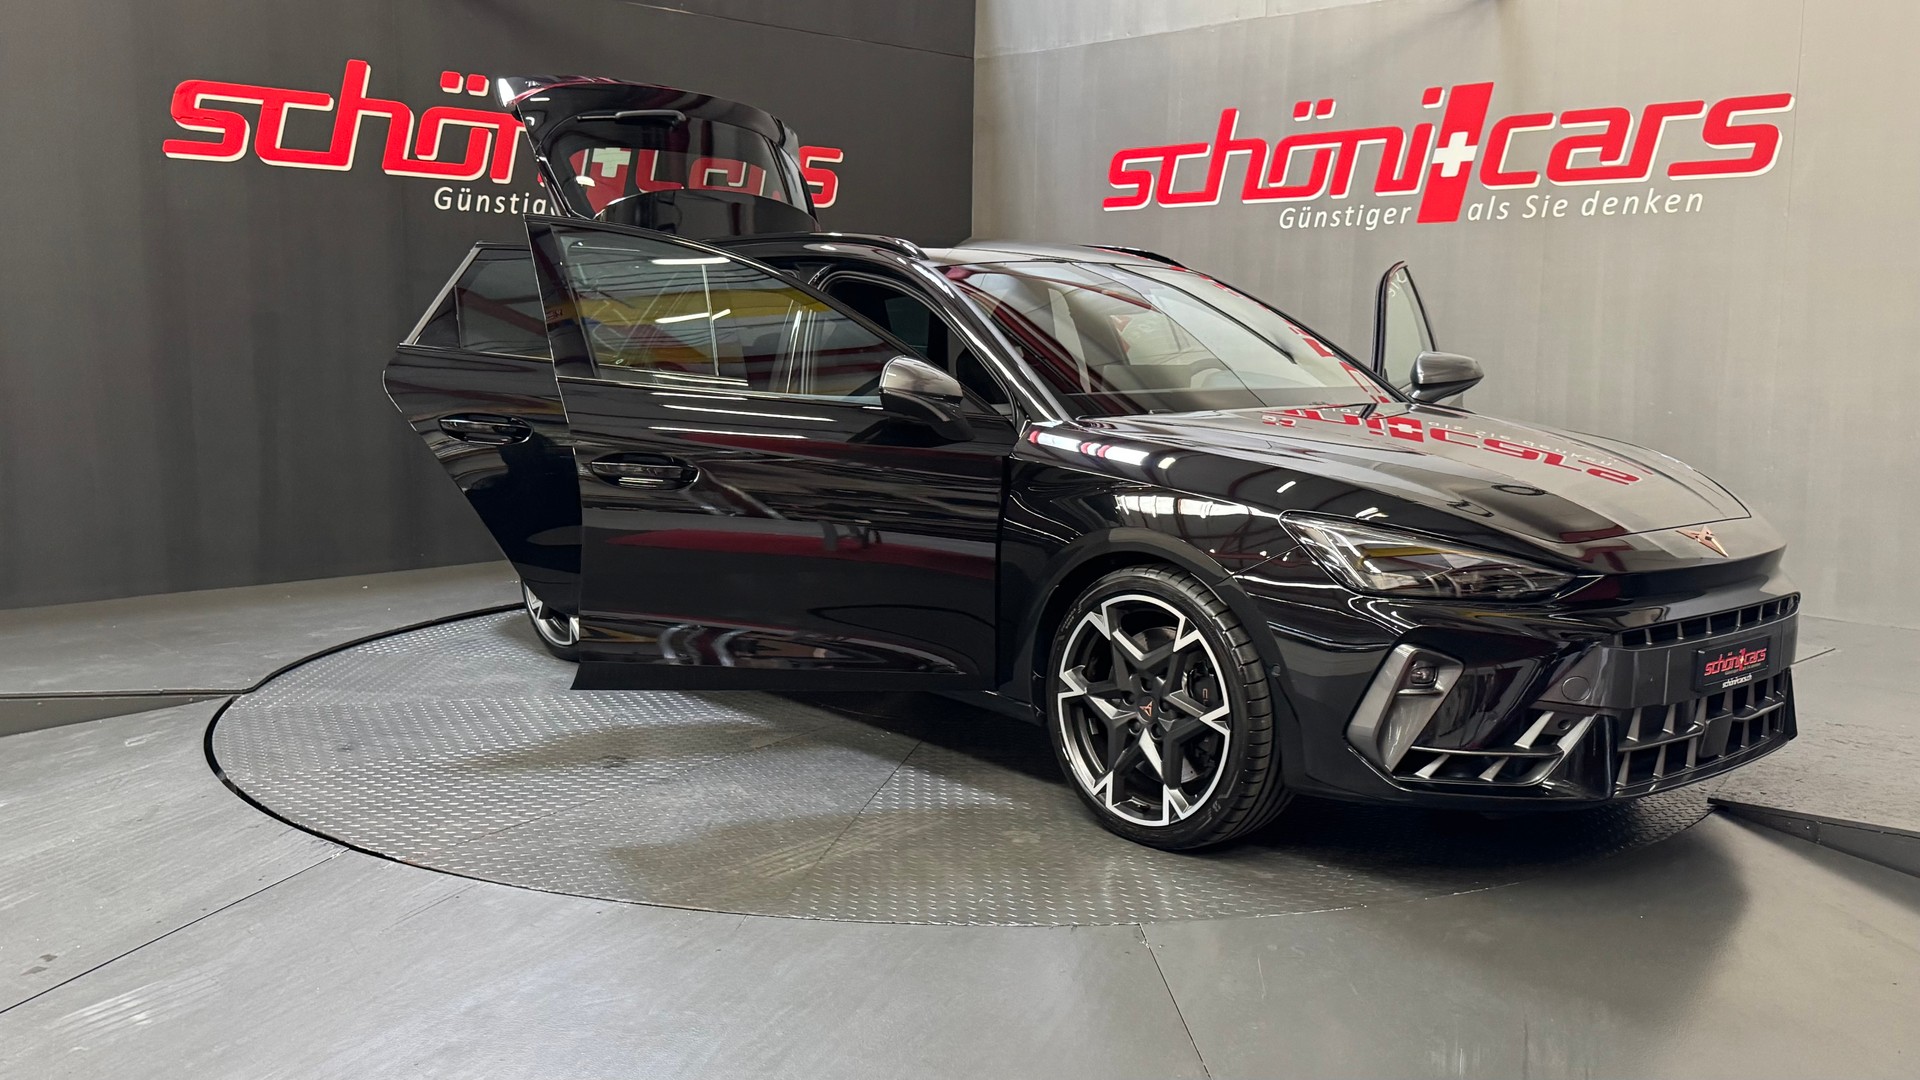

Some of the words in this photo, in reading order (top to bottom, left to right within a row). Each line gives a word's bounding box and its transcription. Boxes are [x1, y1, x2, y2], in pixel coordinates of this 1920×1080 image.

[434, 186, 556, 216] Günstig
[1279, 204, 1412, 231] Günstiger
[1467, 196, 1511, 221] als
[1522, 194, 1569, 219] Sie
[1581, 188, 1704, 217] denken
